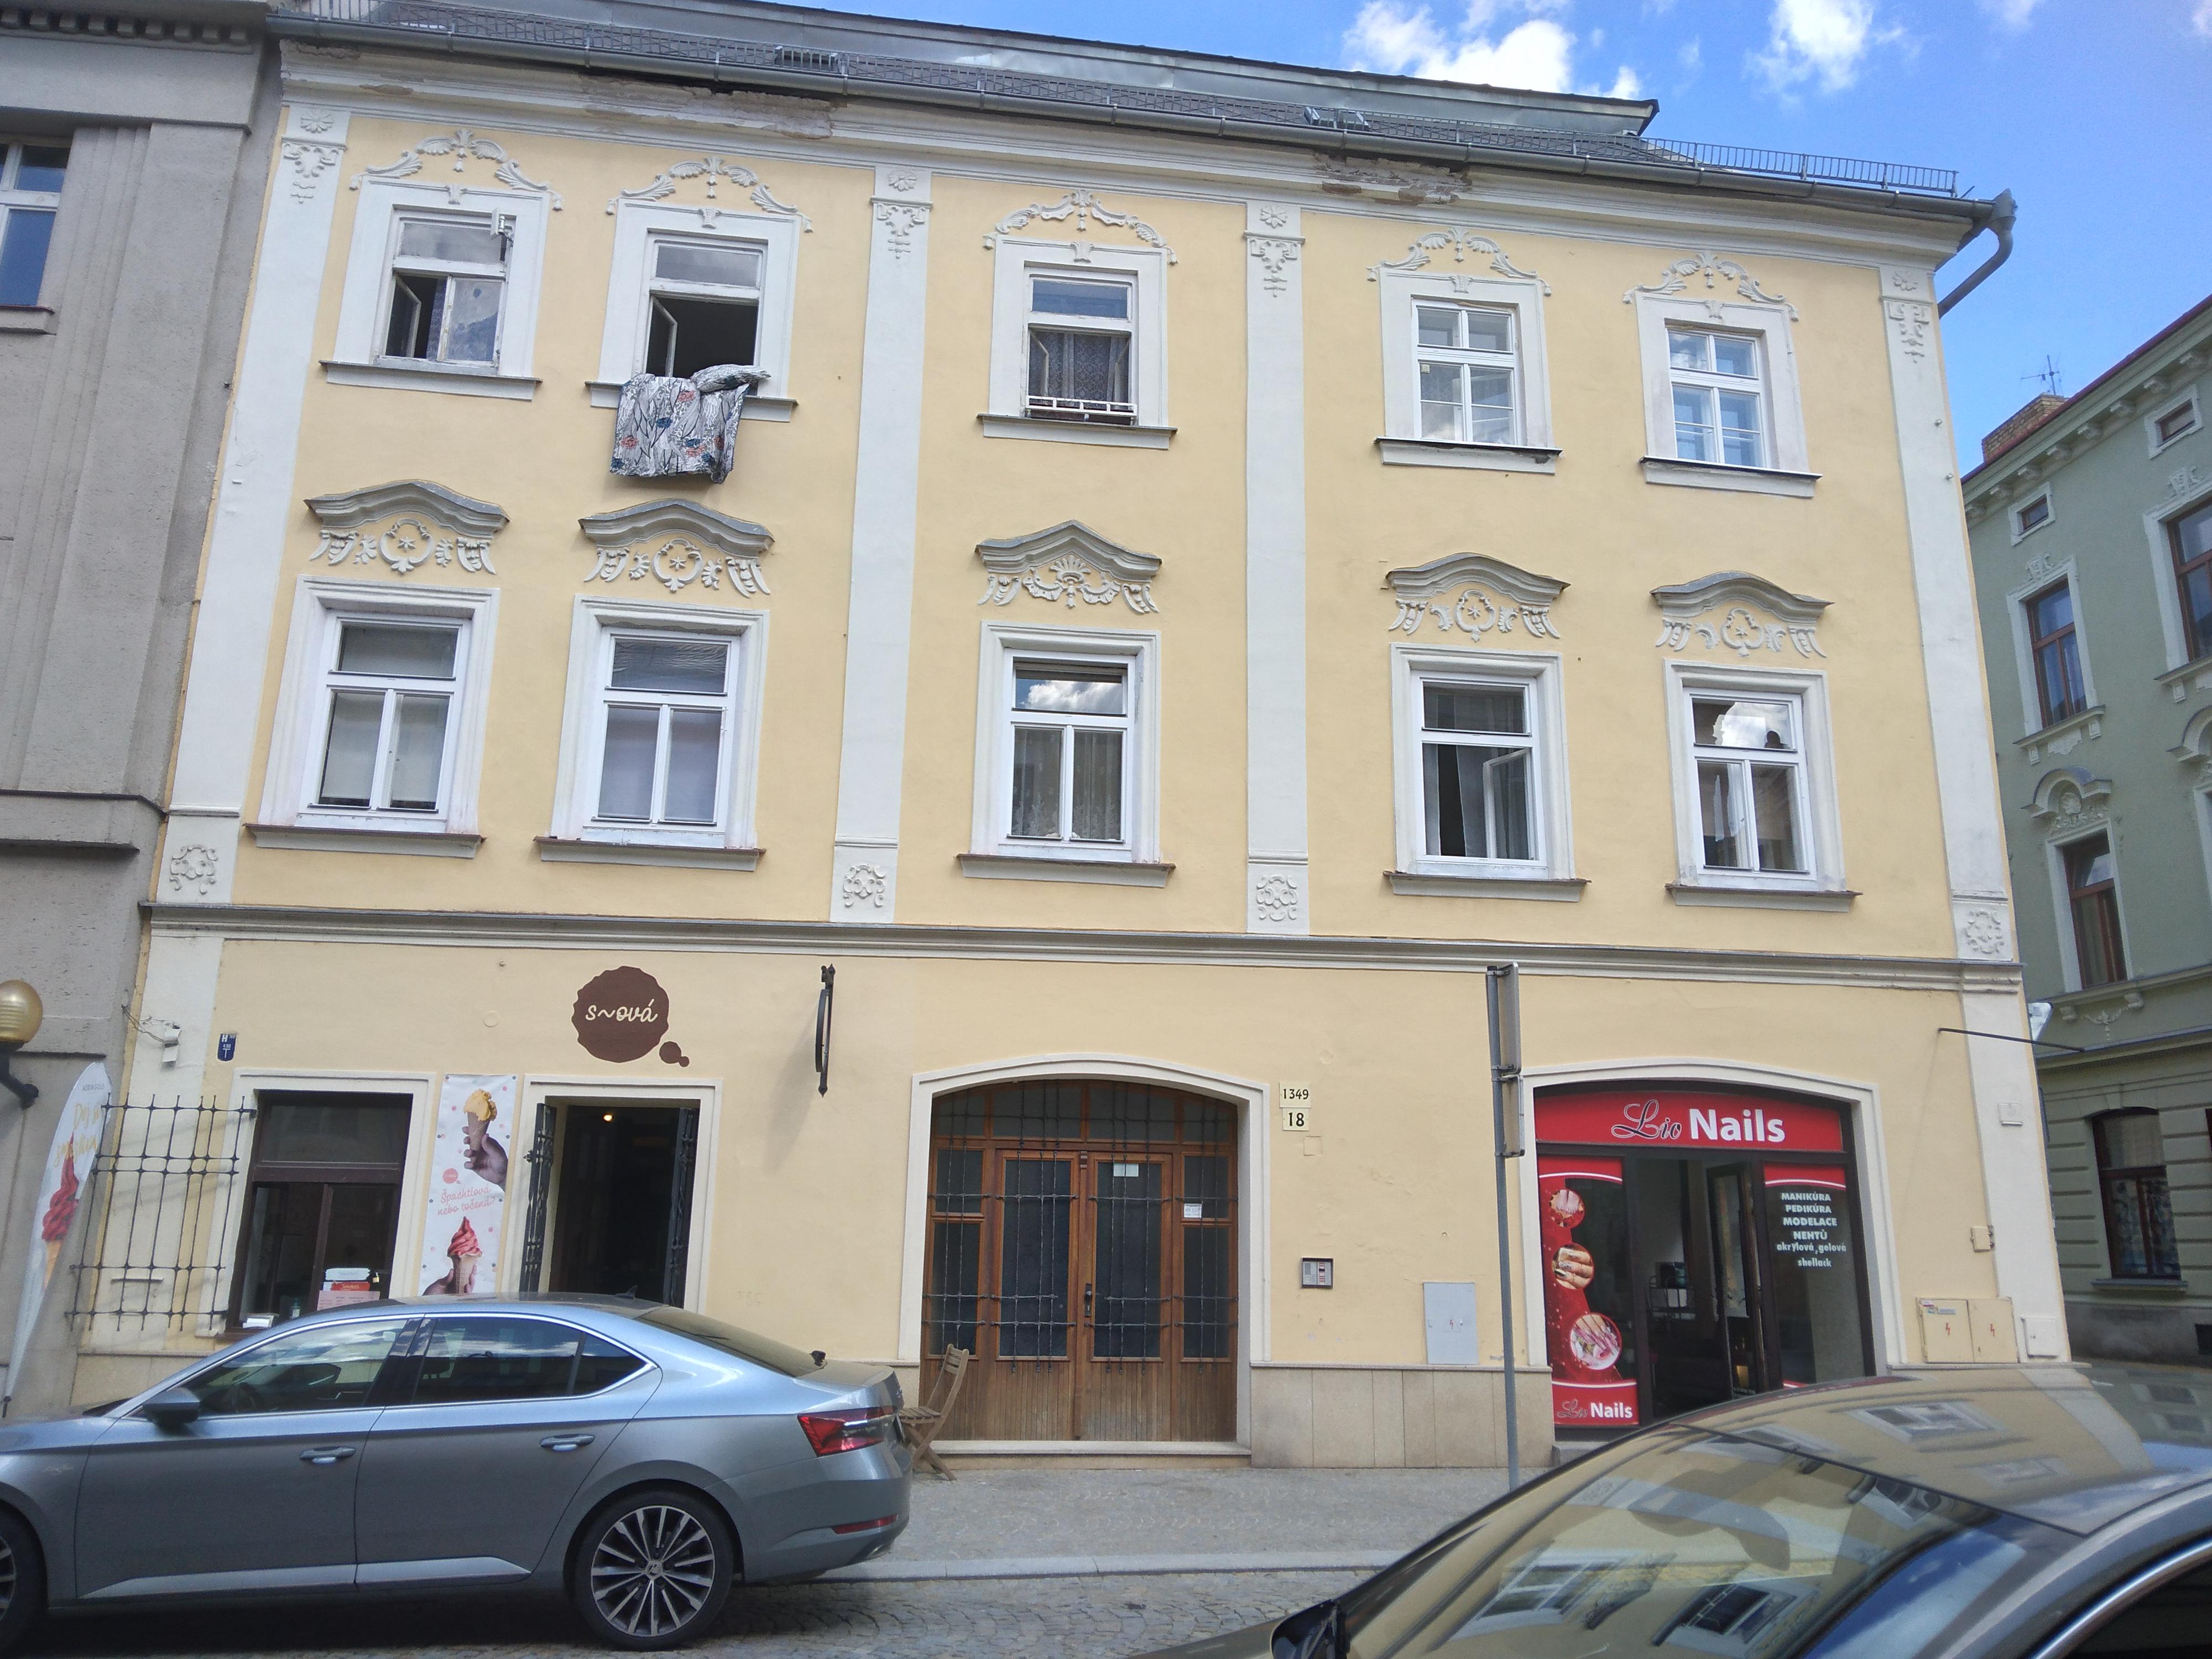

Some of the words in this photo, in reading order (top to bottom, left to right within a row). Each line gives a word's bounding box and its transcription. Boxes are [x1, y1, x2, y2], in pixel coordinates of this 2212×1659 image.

[1283, 1088, 1309, 1100] 1349
[1288, 1112, 1305, 1127] 18
[1689, 1108, 1786, 1142] Nails
[1781, 1191, 1832, 1202] MANIKÚRA
[437, 1204, 460, 1216] nebo
[1785, 1203, 1832, 1213] PEDIKÚRA
[1783, 1217, 1838, 1226] MODELACE
[1793, 1228, 1828, 1240] NEHTŮ
[1797, 1257, 1832, 1267] shellack
[1590, 1401, 1633, 1419] Nails
